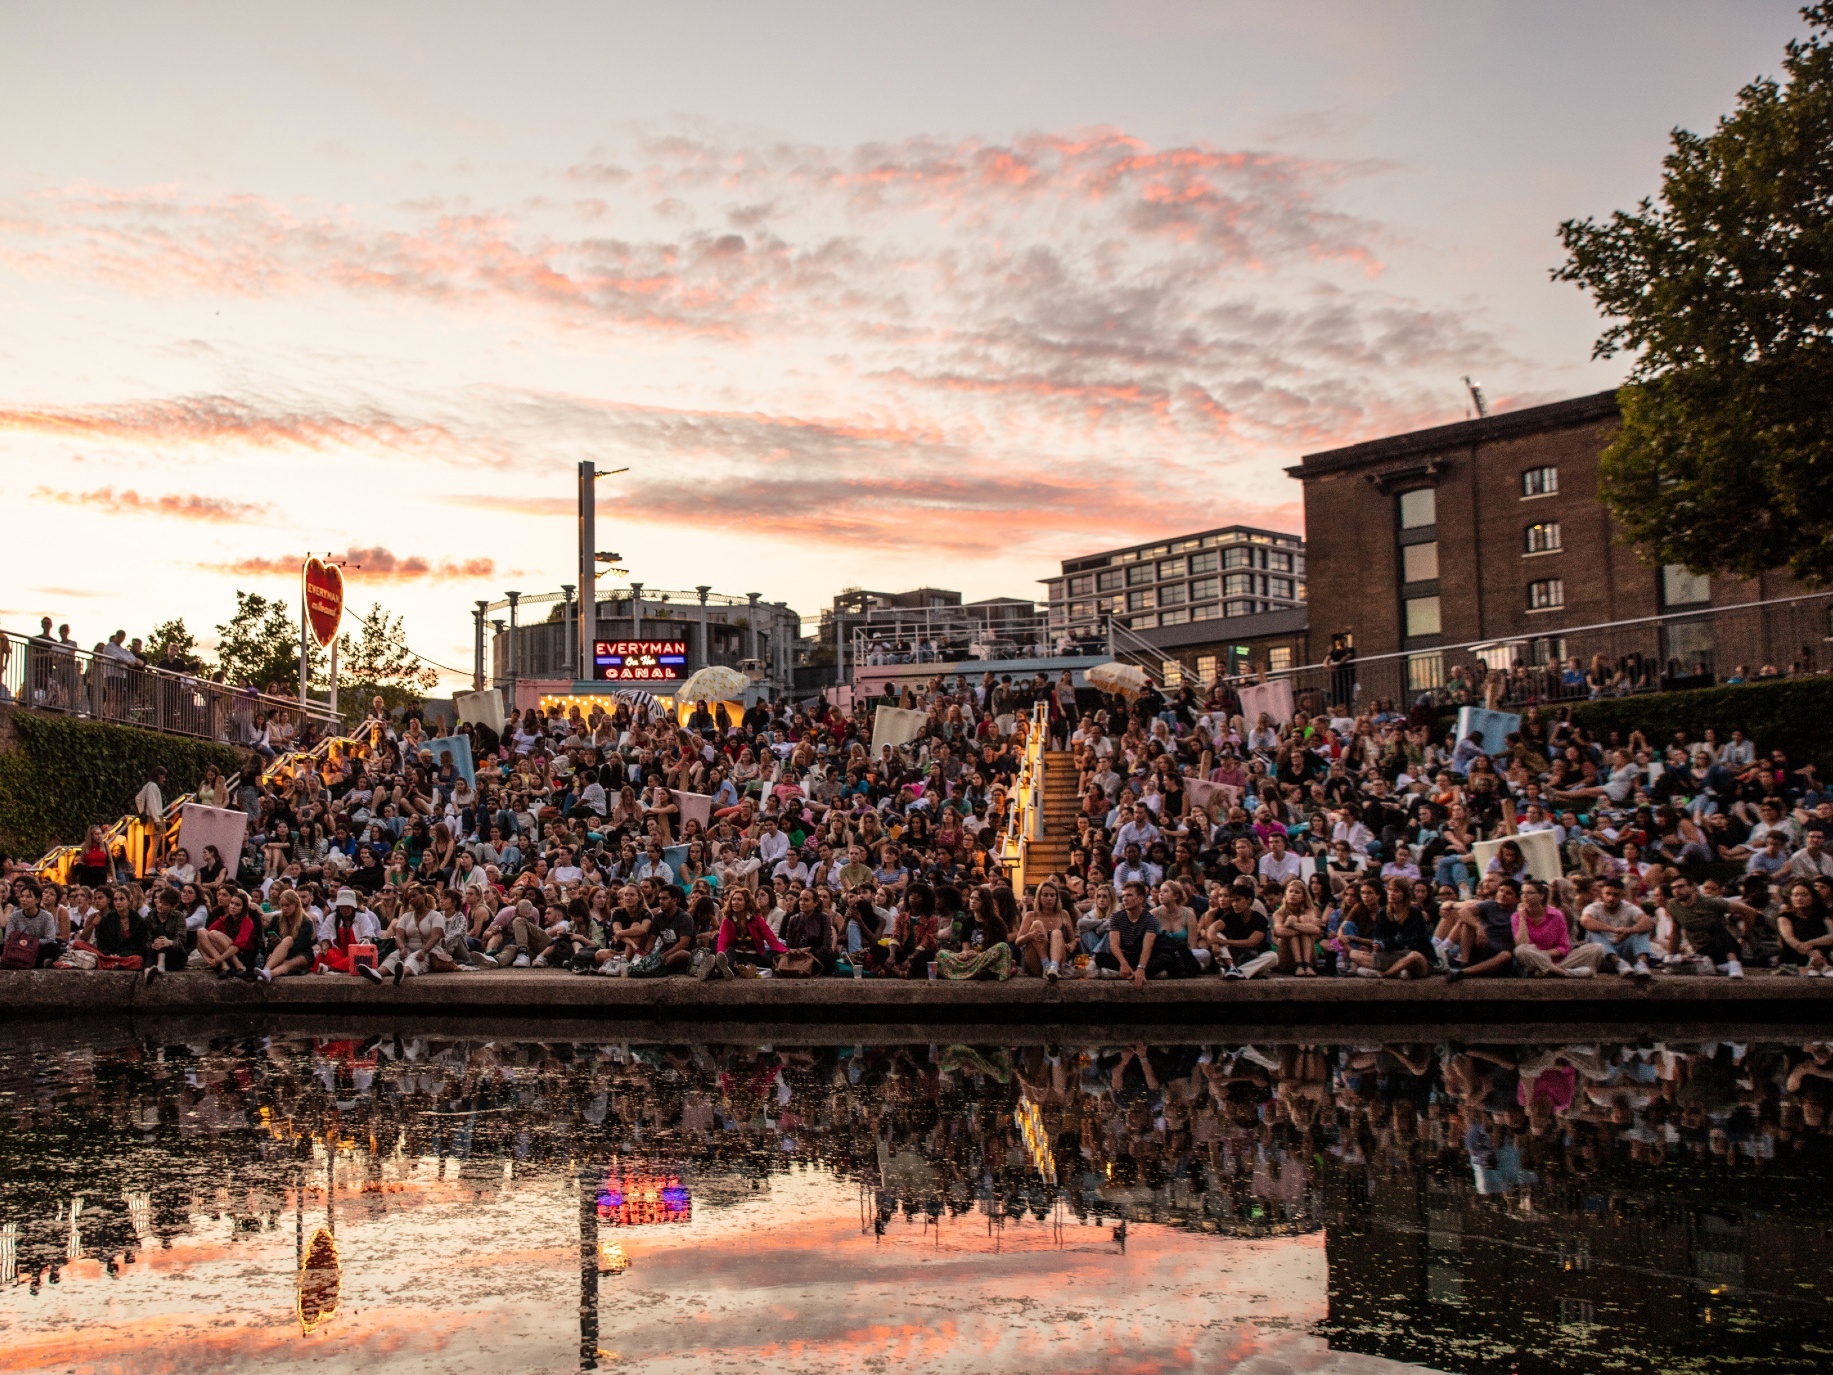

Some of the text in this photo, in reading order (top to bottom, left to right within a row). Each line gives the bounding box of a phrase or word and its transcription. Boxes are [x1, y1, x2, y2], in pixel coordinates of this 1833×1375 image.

[307, 583, 340, 603] EVERYMAN
[596, 643, 685, 655] EVERYMAN
[625, 656, 639, 666] On
[606, 668, 676, 678] CANAL
